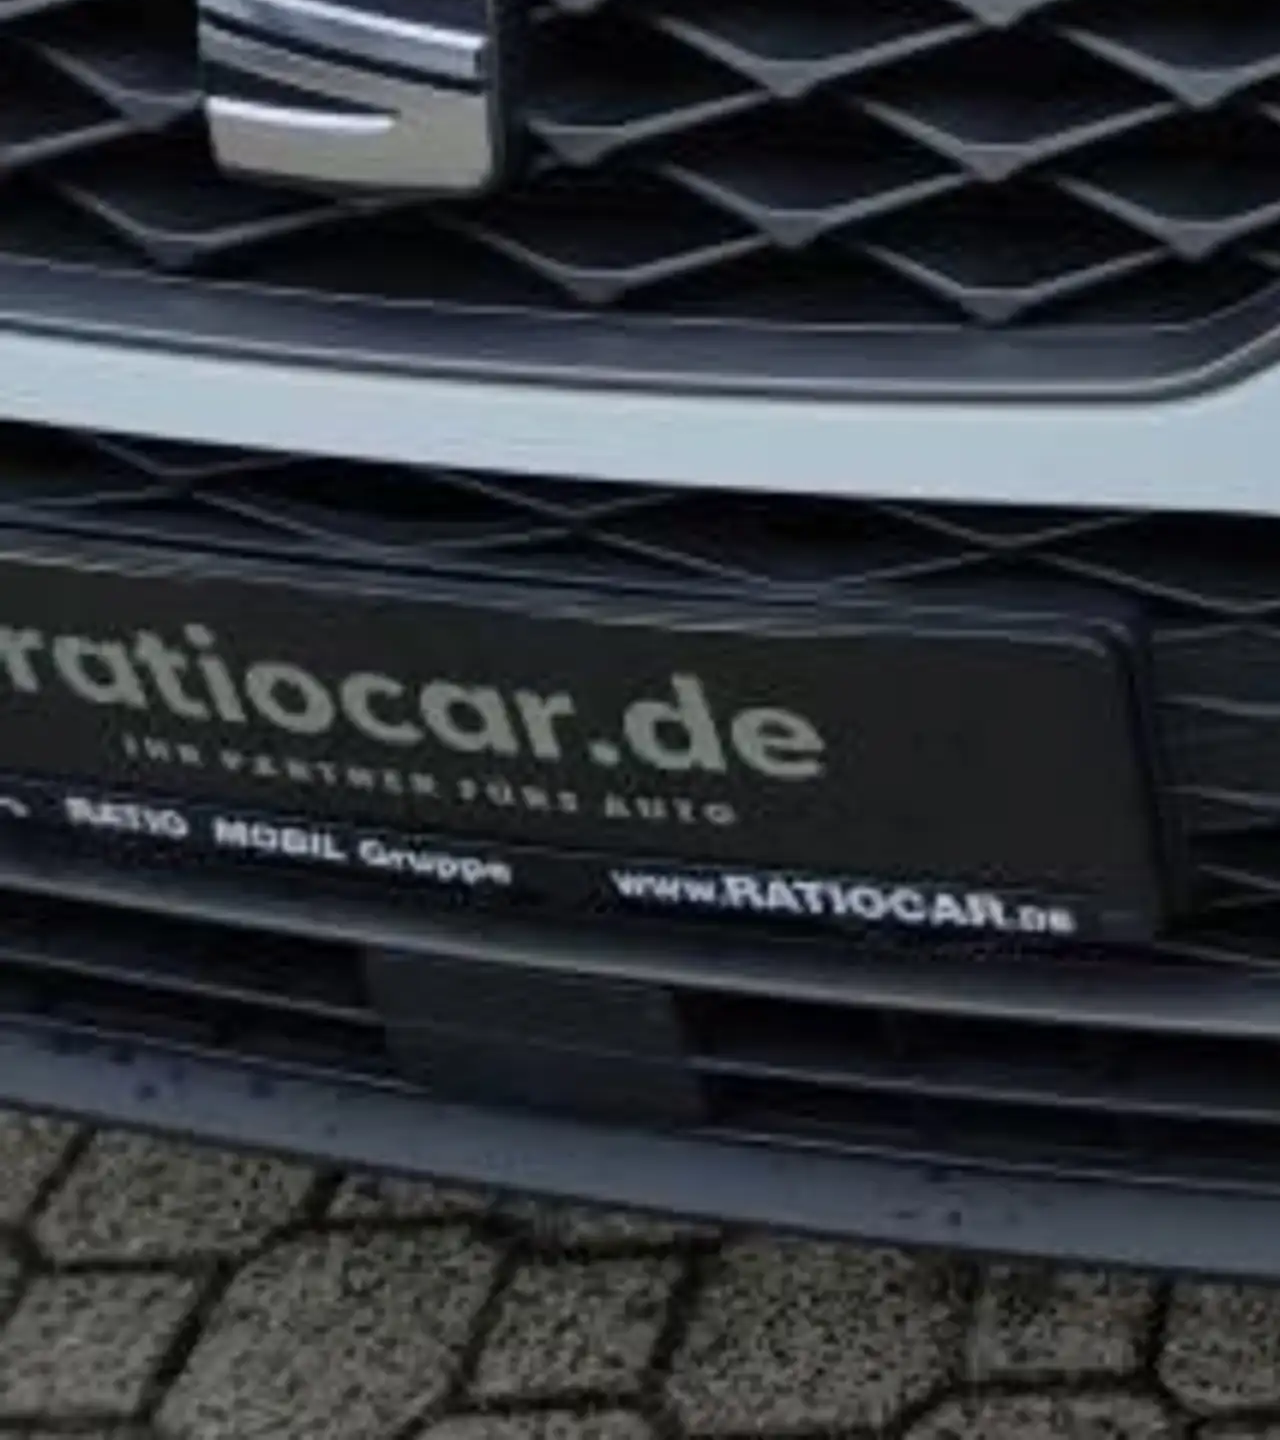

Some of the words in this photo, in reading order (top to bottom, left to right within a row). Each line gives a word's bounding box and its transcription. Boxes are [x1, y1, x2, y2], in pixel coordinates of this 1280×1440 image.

[0, 622, 826, 781] ratiocar.de
[64, 796, 190, 841] RATIO
[212, 815, 347, 861] MOBIL
[358, 838, 512, 888] Gruppe
[604, 792, 738, 827] AUTO
